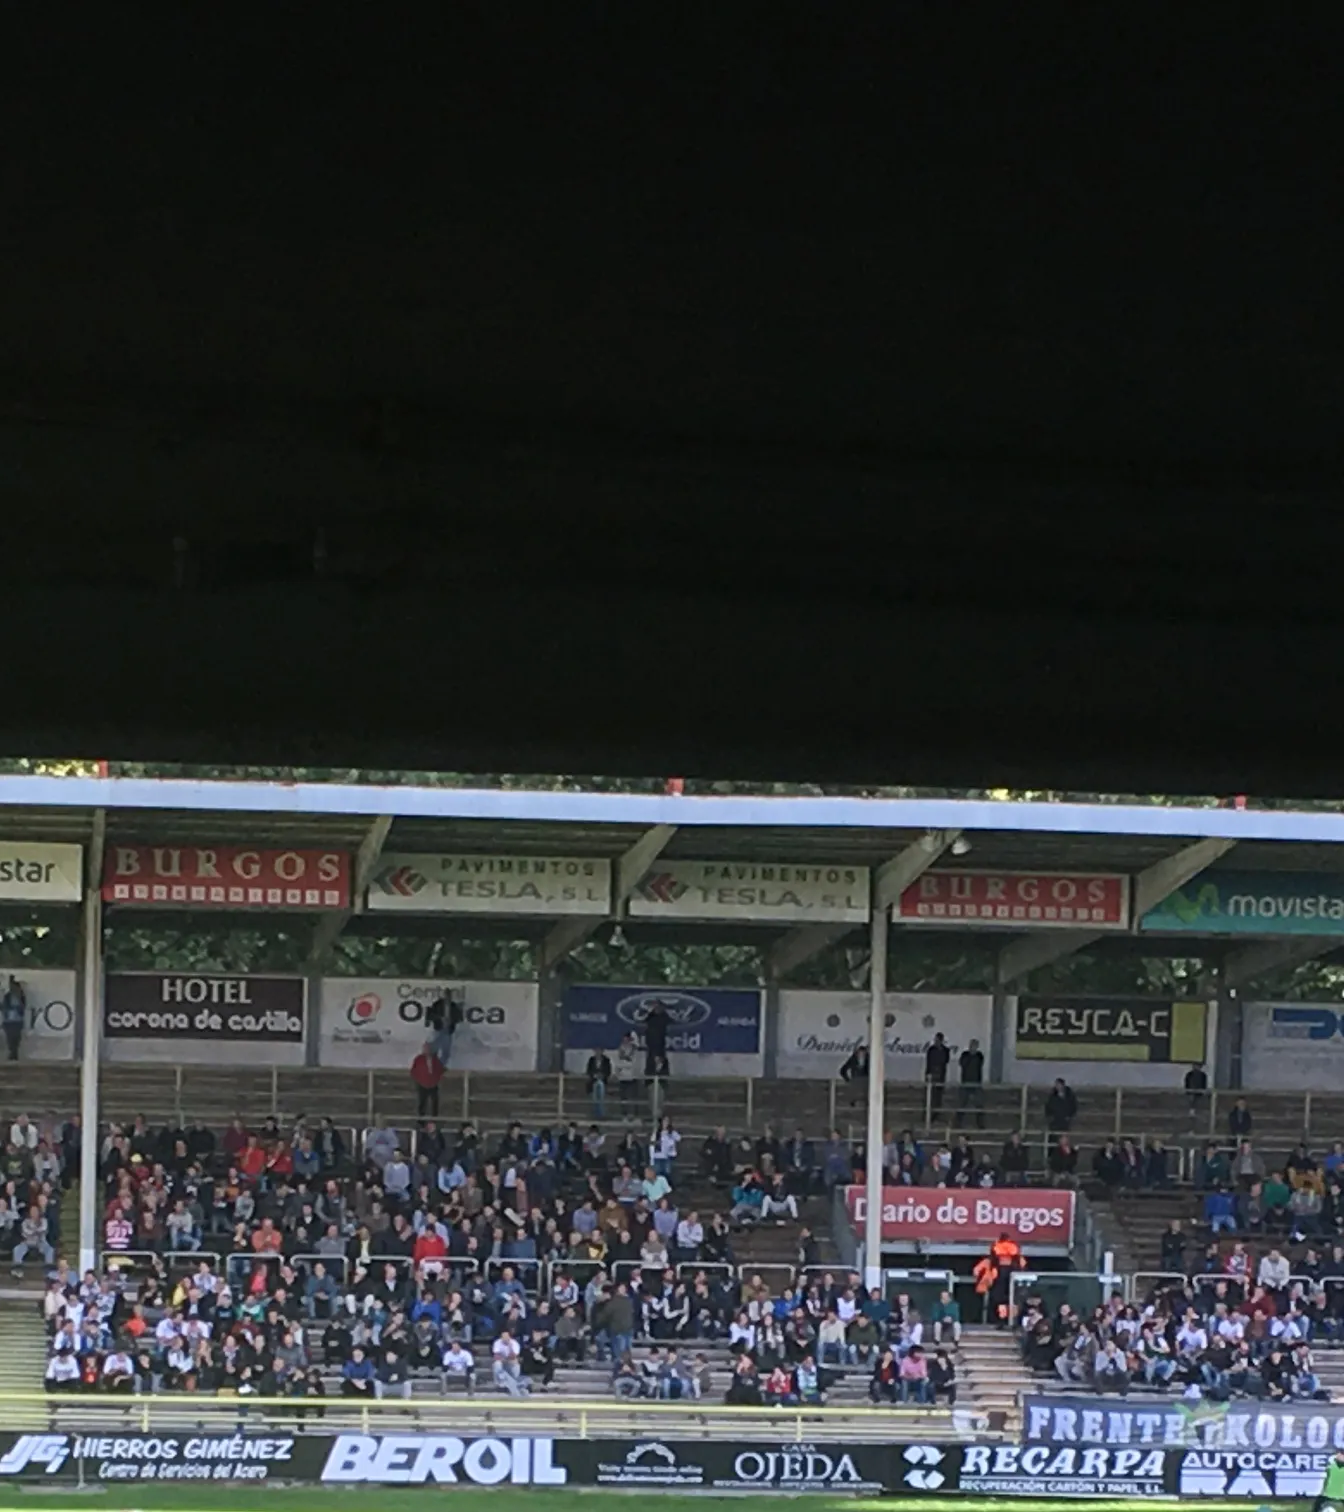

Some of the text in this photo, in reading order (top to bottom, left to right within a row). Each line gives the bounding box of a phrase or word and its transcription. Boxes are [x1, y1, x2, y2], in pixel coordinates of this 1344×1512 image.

[114, 846, 341, 882] BURGOS
[440, 857, 595, 877] PAVIMENTOS
[703, 866, 857, 885] PAVIMENTOS
[918, 875, 1107, 902] BURGOS
[161, 978, 252, 1004] HOTEL
[107, 1008, 302, 1033] corona de castilla
[398, 1003, 505, 1032] Opca
[853, 1198, 1064, 1233] Dario de Burgos
[1028, 1405, 1186, 1445] FRENTE
[72, 1432, 294, 1461] HIERROS GIMÉNEZ
[320, 1435, 567, 1485] BEROIL
[735, 1451, 862, 1482] OJEDA
[960, 1445, 1166, 1479] RECARPA
